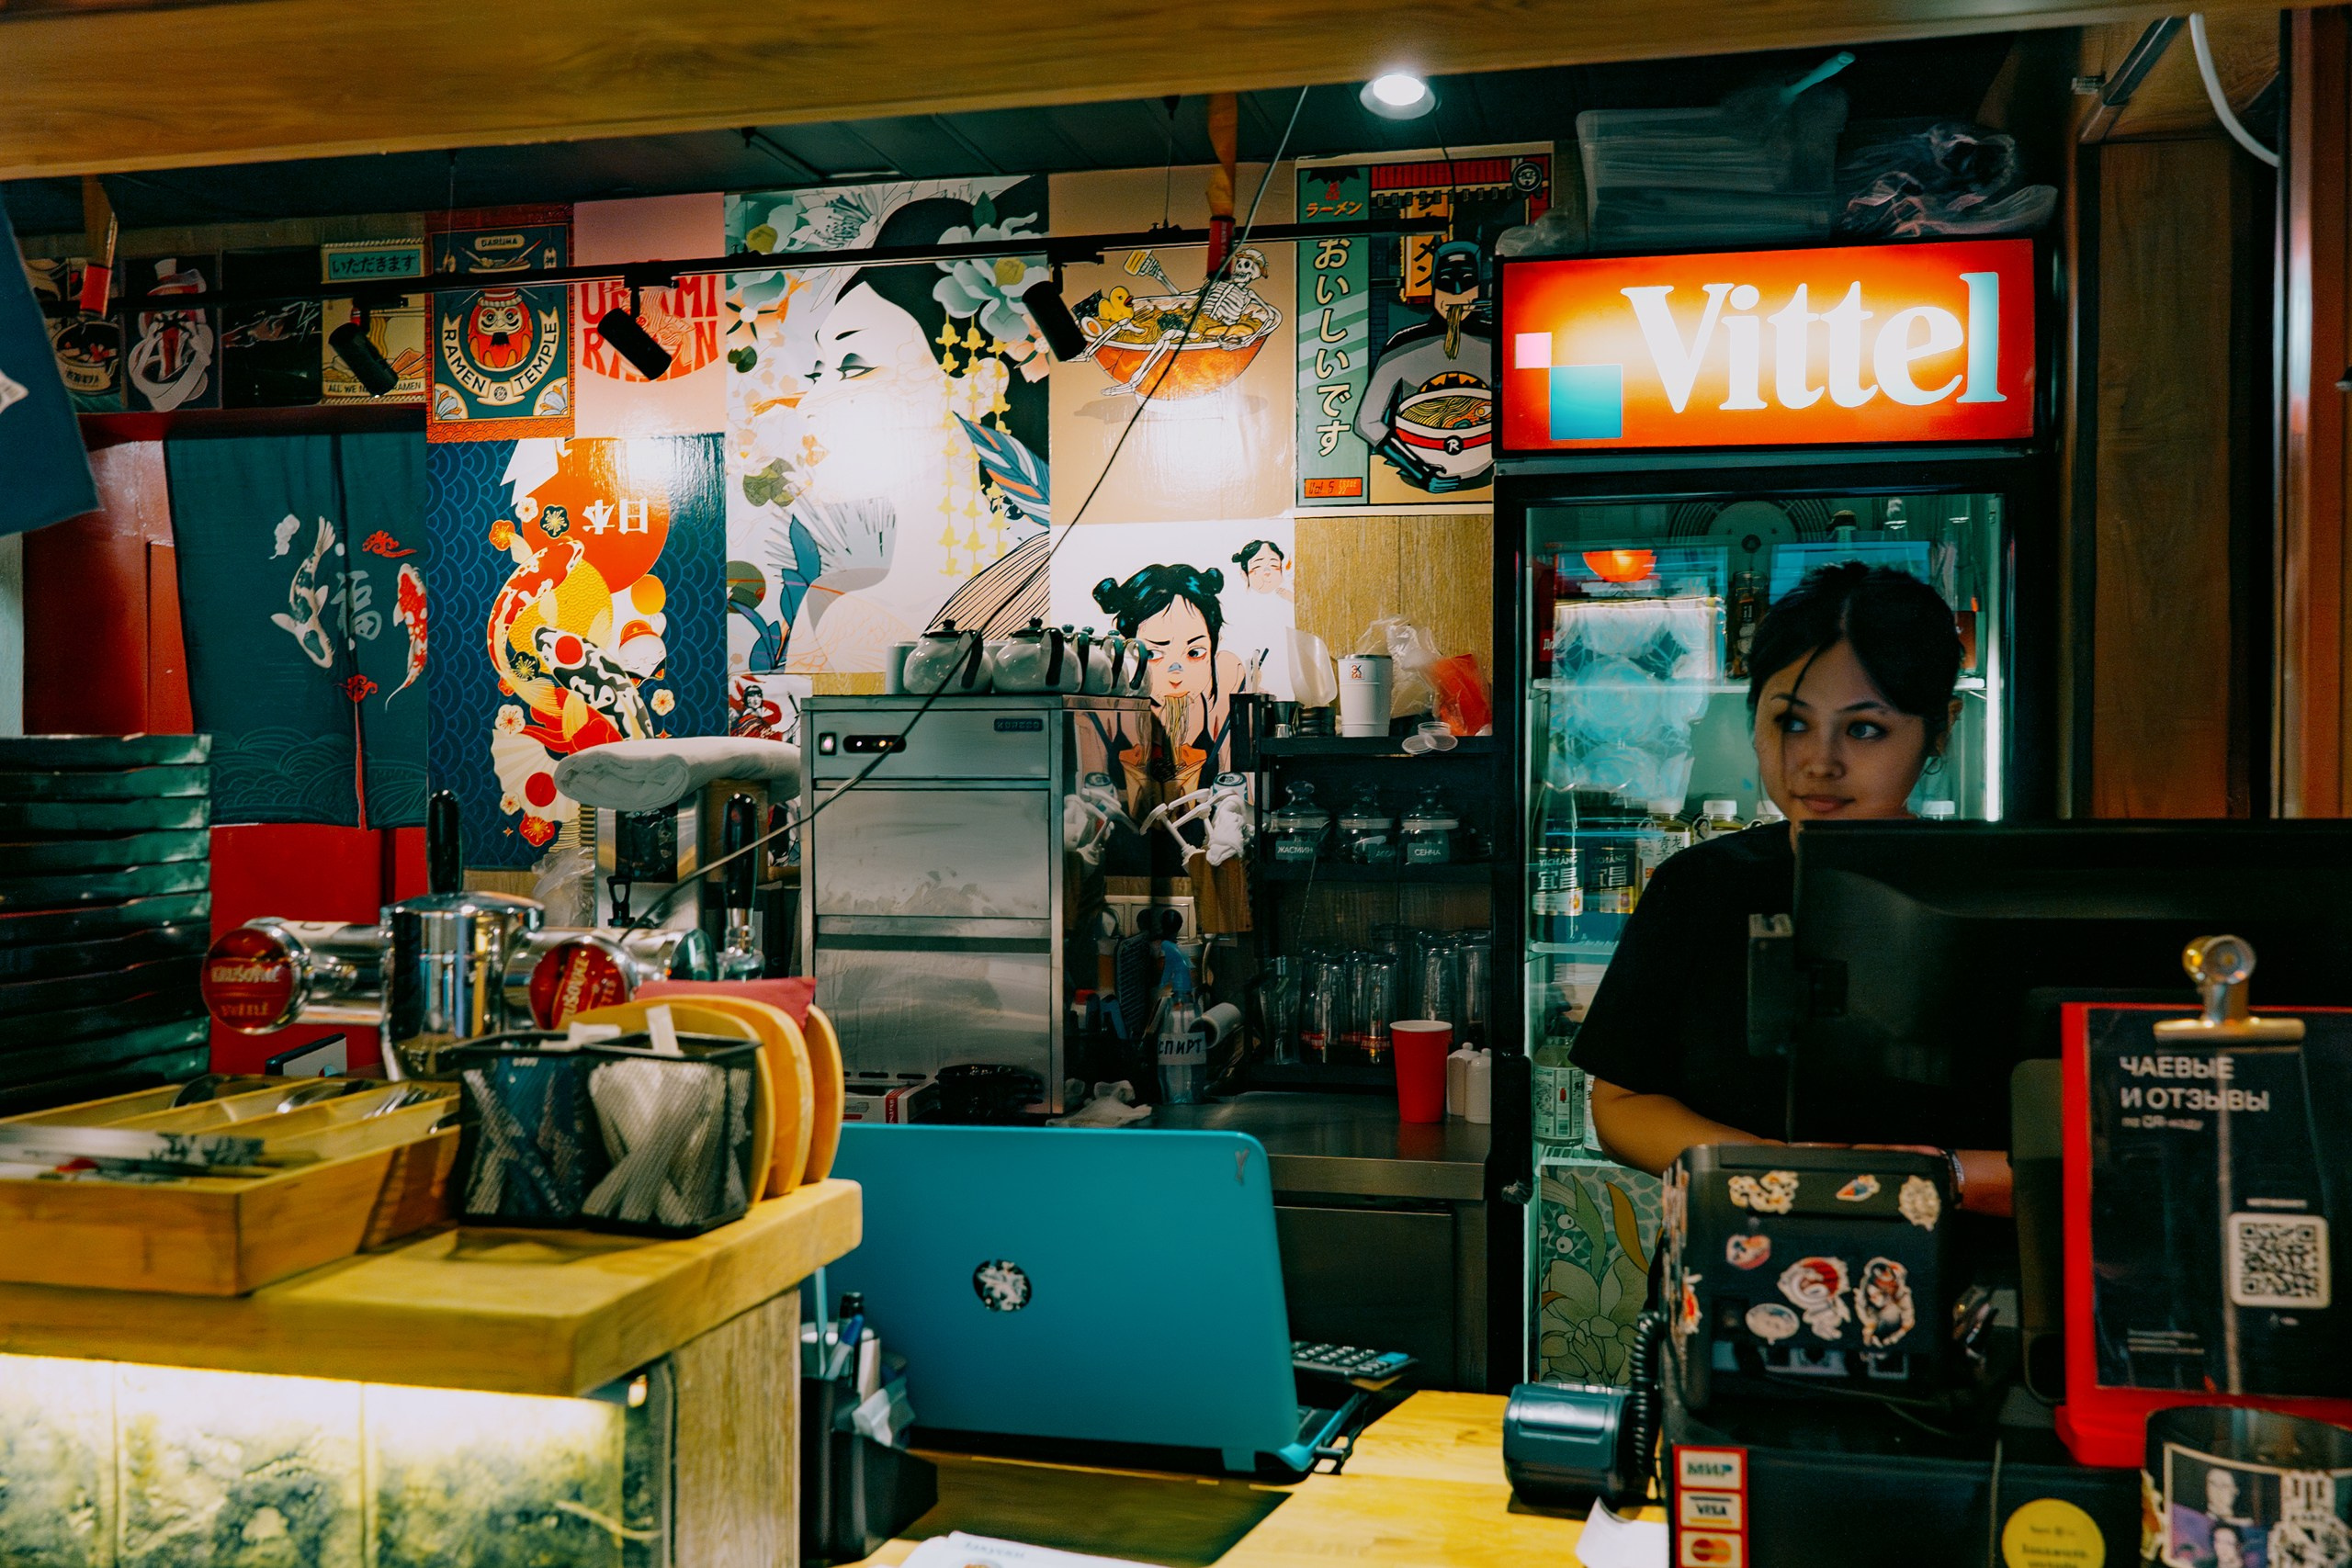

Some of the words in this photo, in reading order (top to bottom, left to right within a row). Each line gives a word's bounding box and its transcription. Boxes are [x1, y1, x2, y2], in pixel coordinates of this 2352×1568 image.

[1306, 199, 1363, 219] ラーメン
[332, 255, 417, 274] いただきます
[1314, 238, 1351, 457] おいしいです
[1621, 272, 2007, 413] Vittel
[443, 328, 489, 398] RAMEN
[513, 321, 558, 394] TEMPLE
[327, 382, 343, 394] ALL
[344, 382, 357, 393] WE
[1276, 844, 1314, 855] ЖАСМИН
[1414, 846, 1442, 857] СЕНЧА
[1158, 1038, 1203, 1055] СПИРТ
[2119, 1056, 2235, 1080] ЧАЕВЫЕ
[2120, 1087, 2143, 1110] И
[2146, 1088, 2270, 1112] ОТЗЫВЫ
